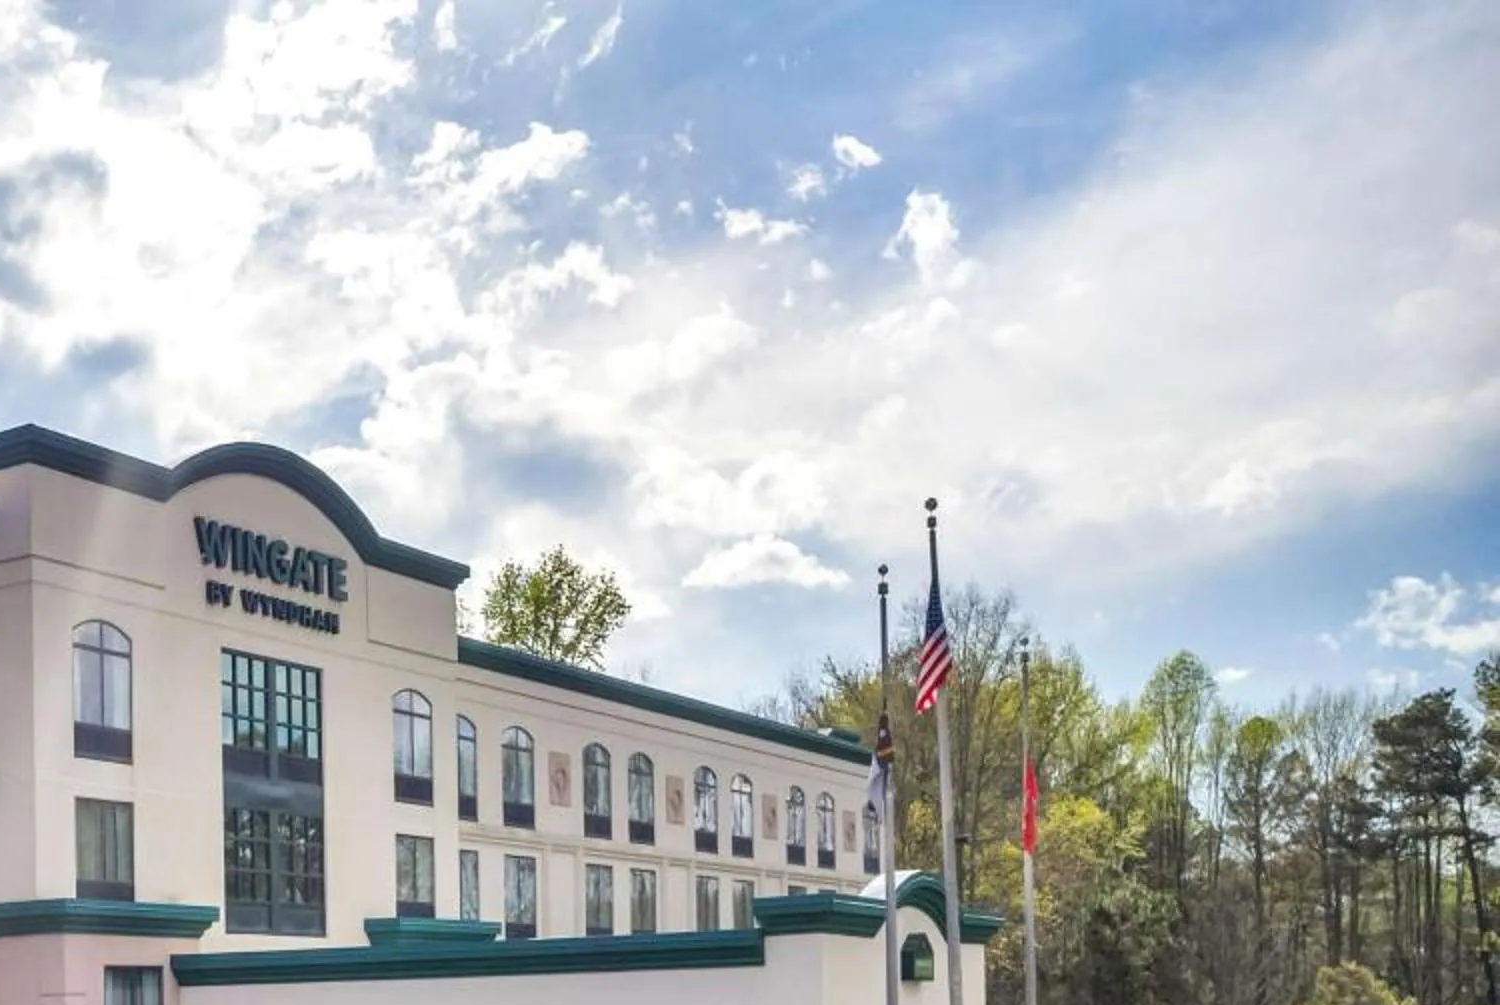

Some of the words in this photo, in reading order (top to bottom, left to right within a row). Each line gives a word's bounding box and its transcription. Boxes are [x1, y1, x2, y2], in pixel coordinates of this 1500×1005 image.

[193, 516, 348, 602] WINGATE
[205, 580, 234, 608] BY
[240, 589, 340, 634] WYNDHAM
